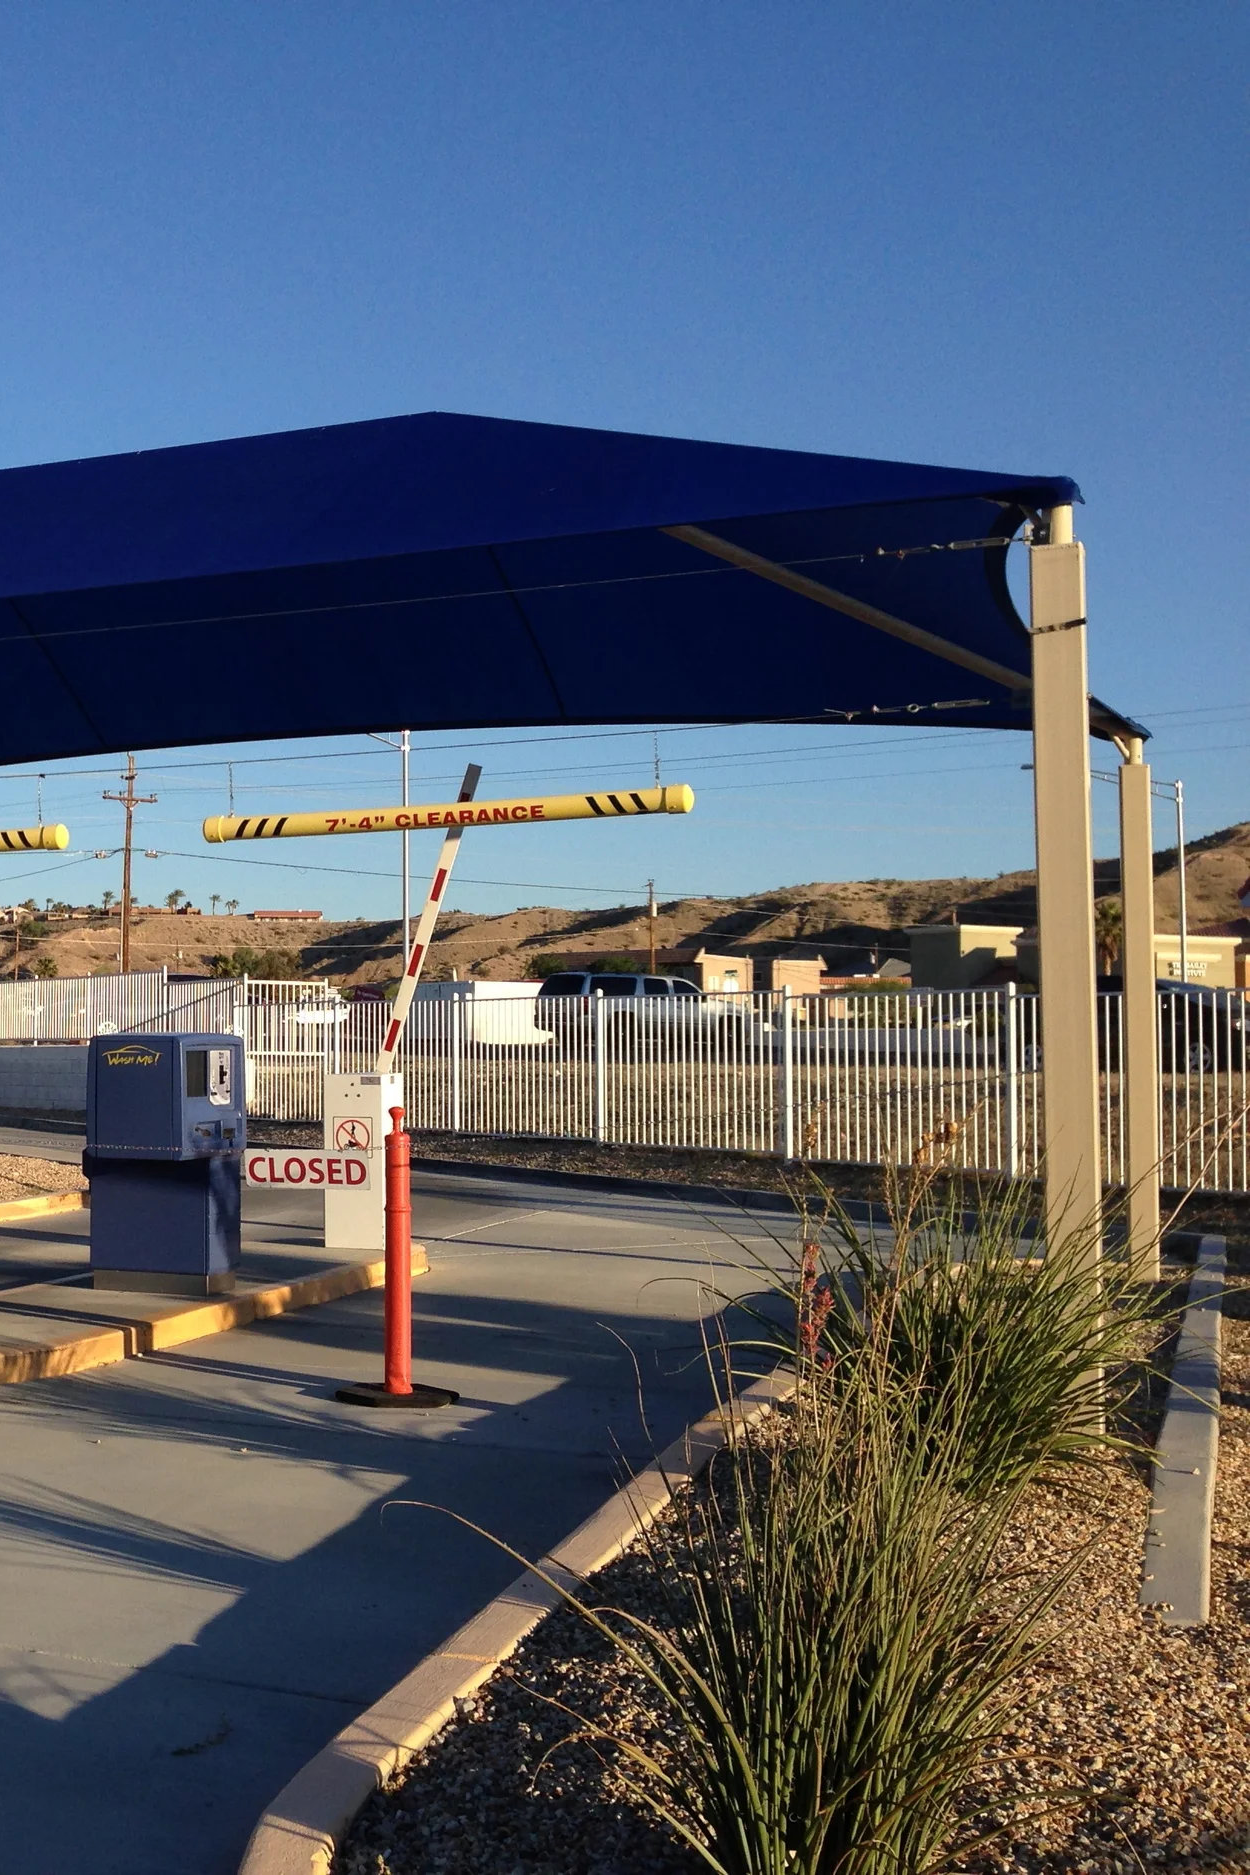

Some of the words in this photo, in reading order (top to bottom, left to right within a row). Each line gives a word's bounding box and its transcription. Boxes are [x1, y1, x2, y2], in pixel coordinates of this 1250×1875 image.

[325, 816, 386, 832] 7'-4"
[395, 804, 546, 829] CLEARANCE
[248, 1156, 368, 1186] CLOSED
